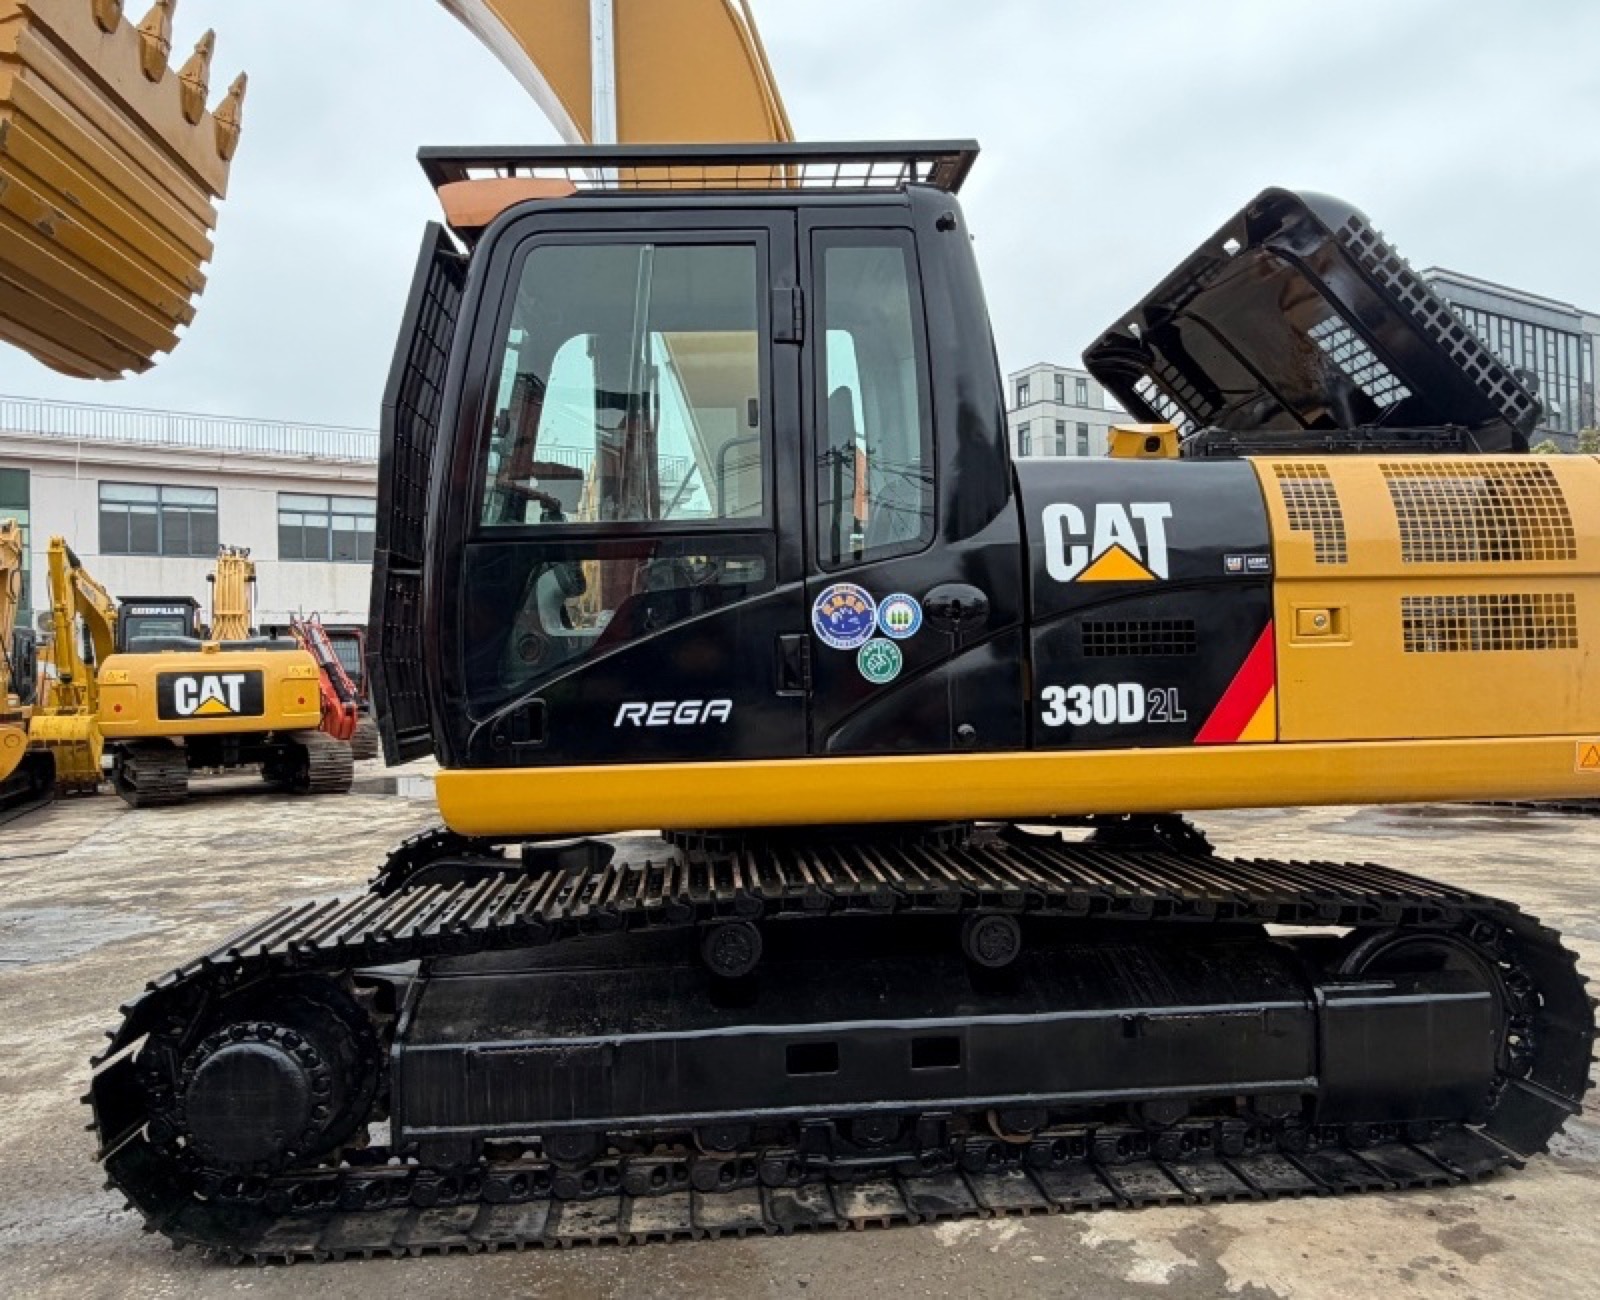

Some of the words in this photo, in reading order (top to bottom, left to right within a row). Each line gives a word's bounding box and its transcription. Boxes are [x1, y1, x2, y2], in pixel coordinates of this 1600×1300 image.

[1041, 502, 1173, 583] CAT
[174, 674, 246, 715] CAT
[613, 698, 732, 727] REGA
